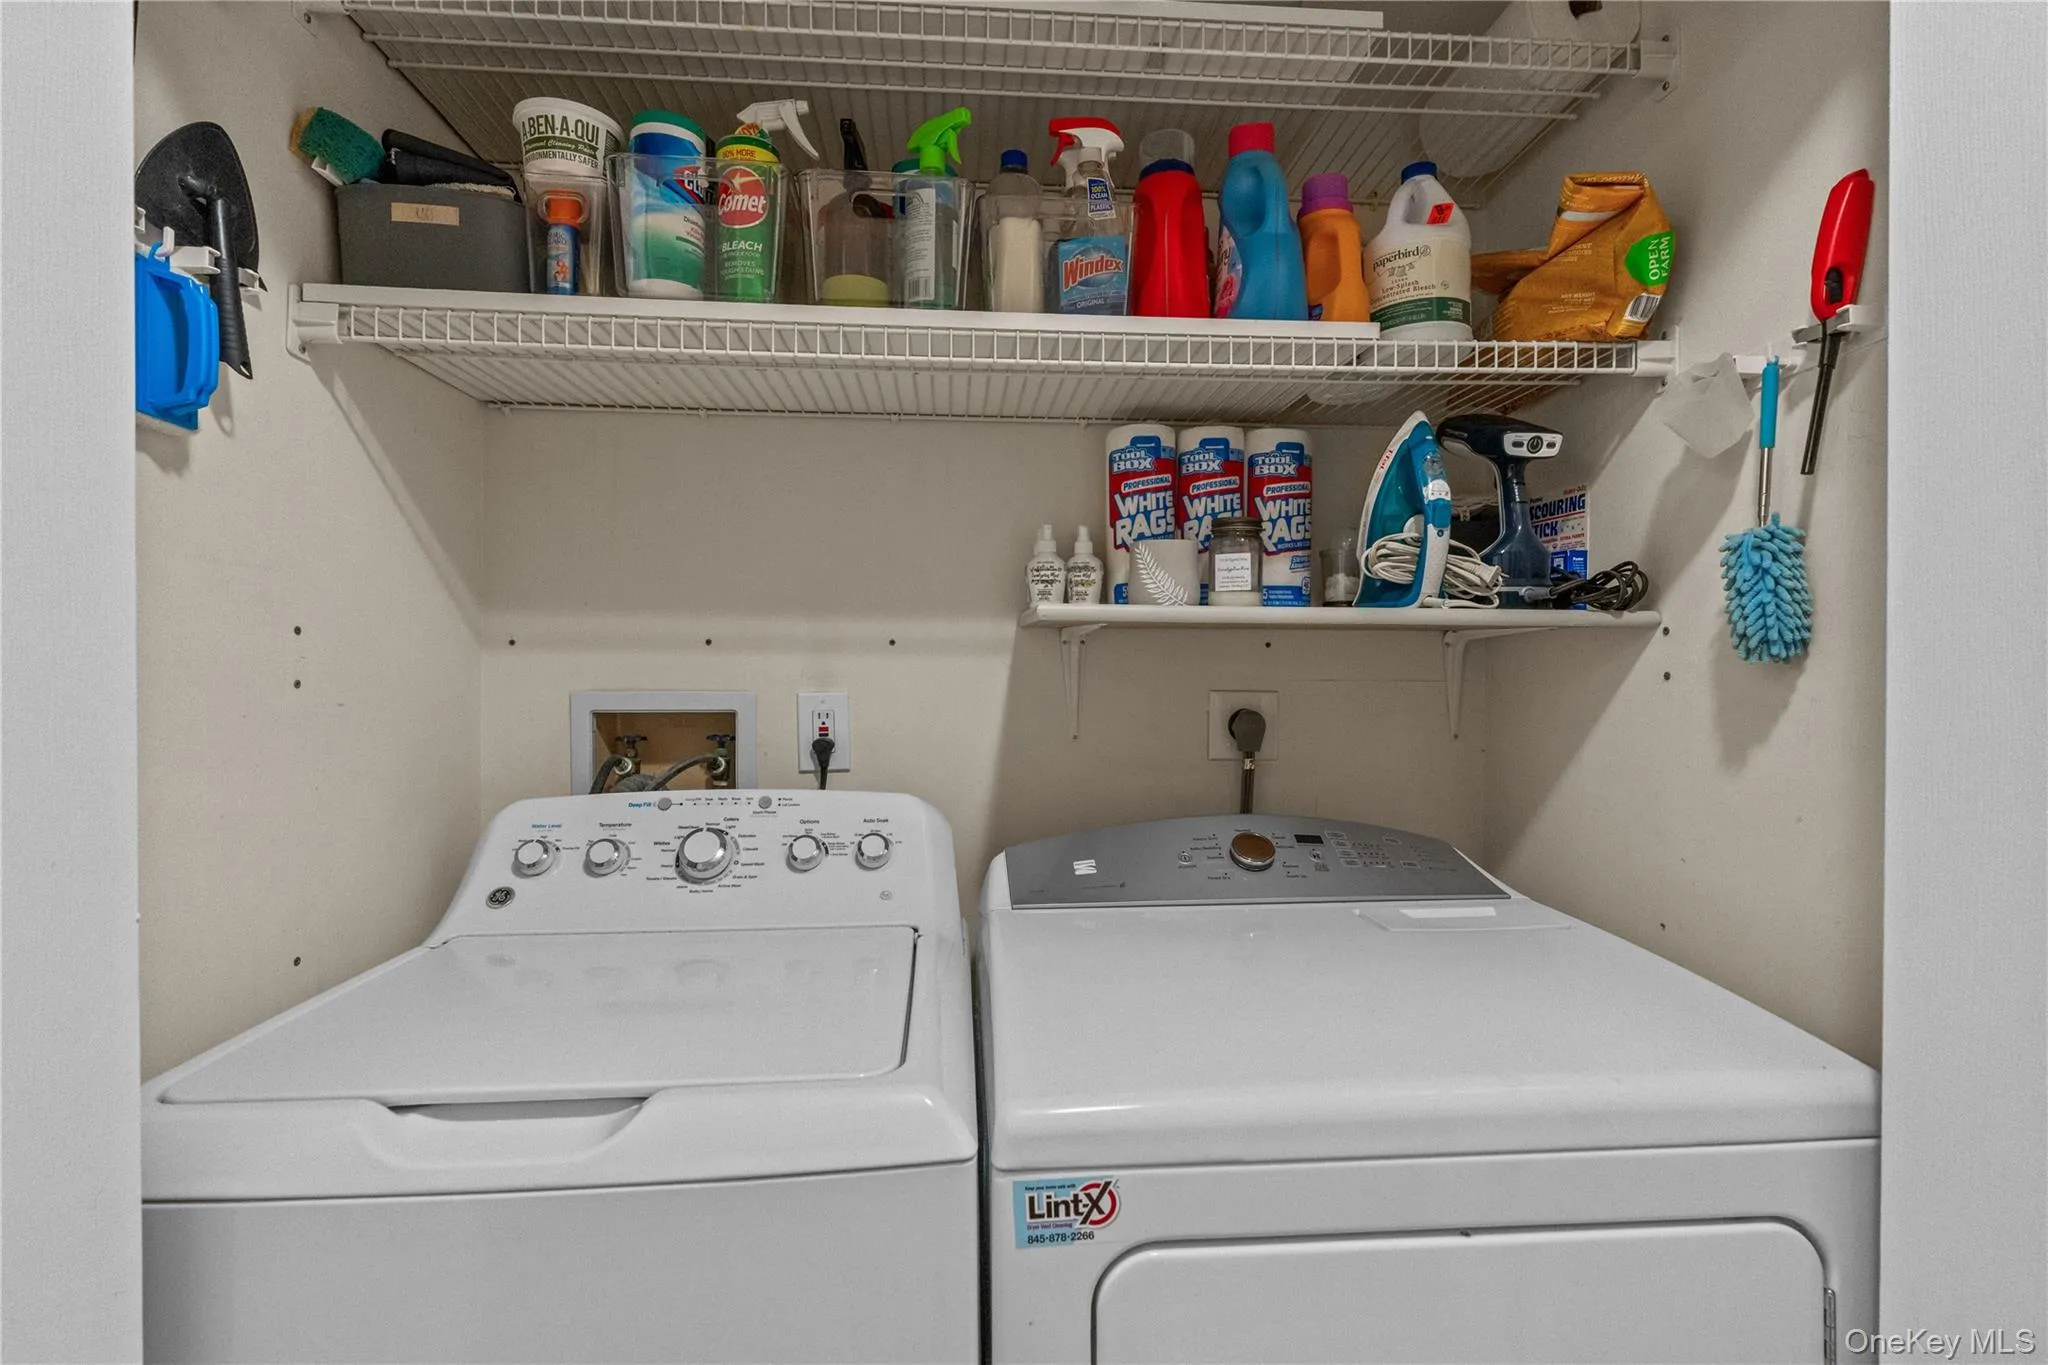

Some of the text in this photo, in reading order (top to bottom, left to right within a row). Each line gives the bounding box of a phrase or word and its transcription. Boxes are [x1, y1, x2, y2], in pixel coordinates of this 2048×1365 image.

[577, 154, 599, 169] SAFER
[718, 192, 767, 215] Comet
[721, 240, 764, 253] BLEACH
[1658, 235, 1672, 277] FARM
[1372, 245, 1420, 273] paperbird
[1648, 237, 1661, 281] OPEN
[1062, 253, 1124, 292] Windex
[1112, 450, 1147, 461] TOOL
[1113, 458, 1153, 473] BOX
[1182, 452, 1217, 462] TOOL
[1182, 460, 1222, 474] BOX
[1254, 455, 1292, 465] TOOL
[1254, 463, 1297, 476] BOX
[1123, 475, 1171, 492] PROFESSIONAL
[1191, 477, 1238, 493] PROFESSIONAL
[1114, 490, 1174, 518] WHITE
[1182, 492, 1241, 520] WHITE
[1254, 496, 1311, 521] WHITE
[1529, 493, 1587, 522] SCOURING
[1115, 506, 1176, 549] RAGS
[1028, 1181, 1113, 1226] Lint-X
